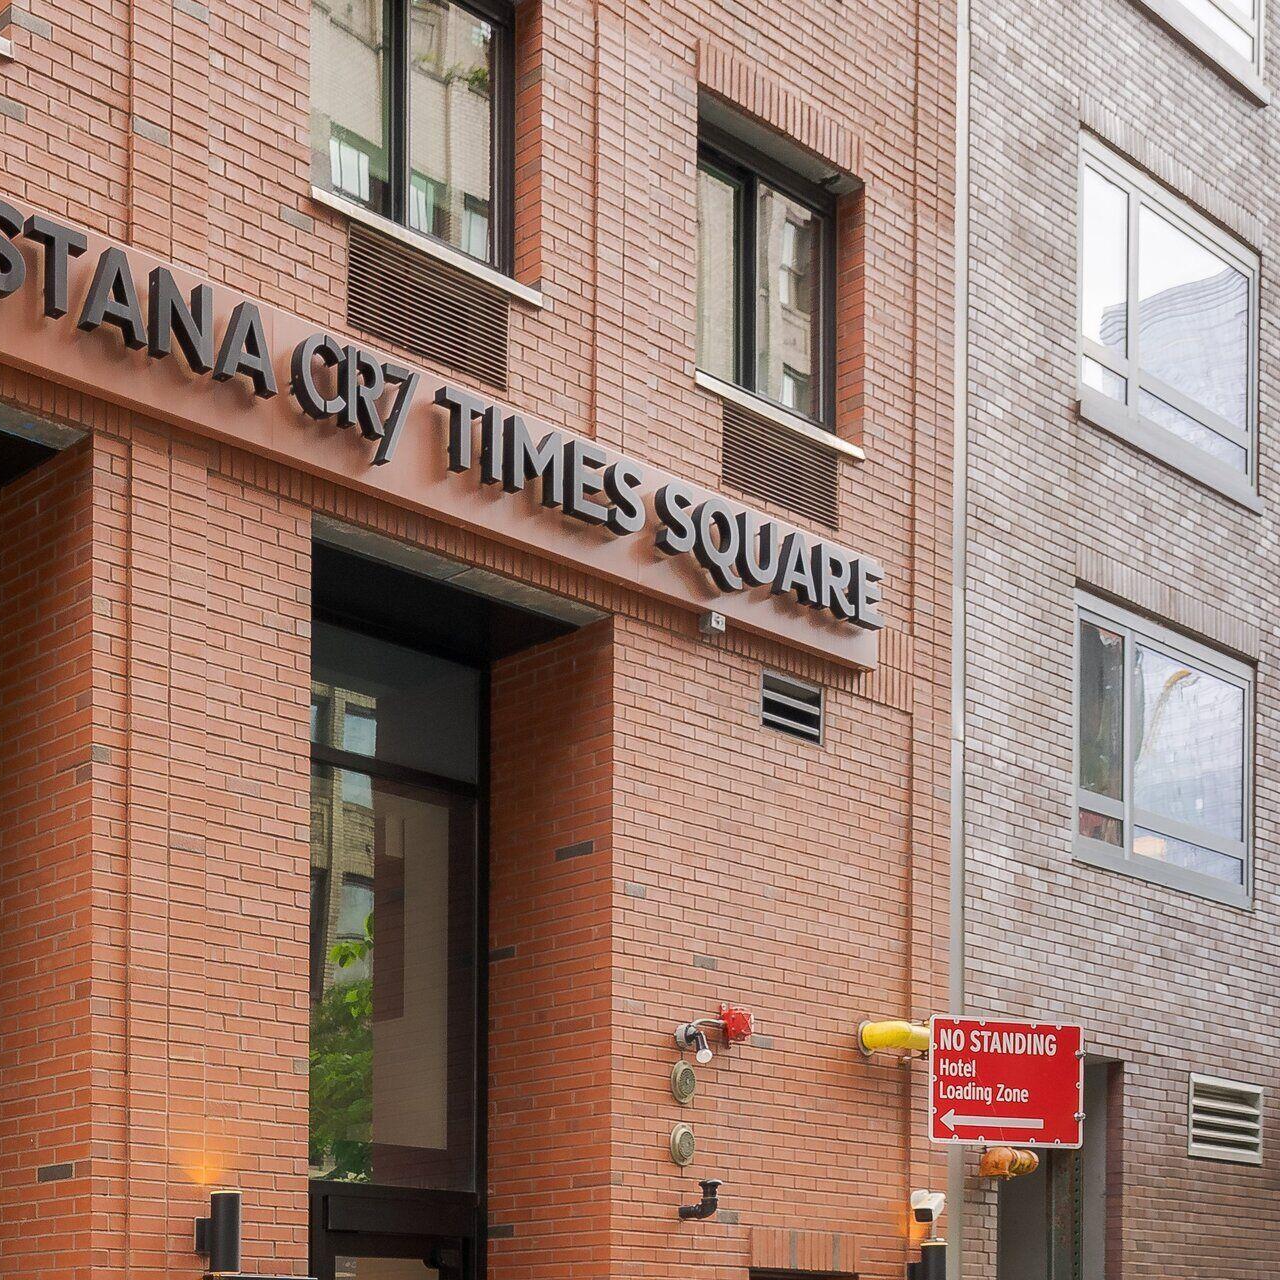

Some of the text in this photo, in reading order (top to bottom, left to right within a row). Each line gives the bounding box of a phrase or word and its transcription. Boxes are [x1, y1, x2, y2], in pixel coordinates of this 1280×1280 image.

[290, 333, 420, 467] CR7
[435, 384, 647, 537] TIMES
[654, 482, 886, 632] SQUARE
[939, 1028, 1057, 1056] NO STANDING
[939, 1058, 976, 1078] Hotel
[939, 1081, 1029, 1105] Loading Zone
